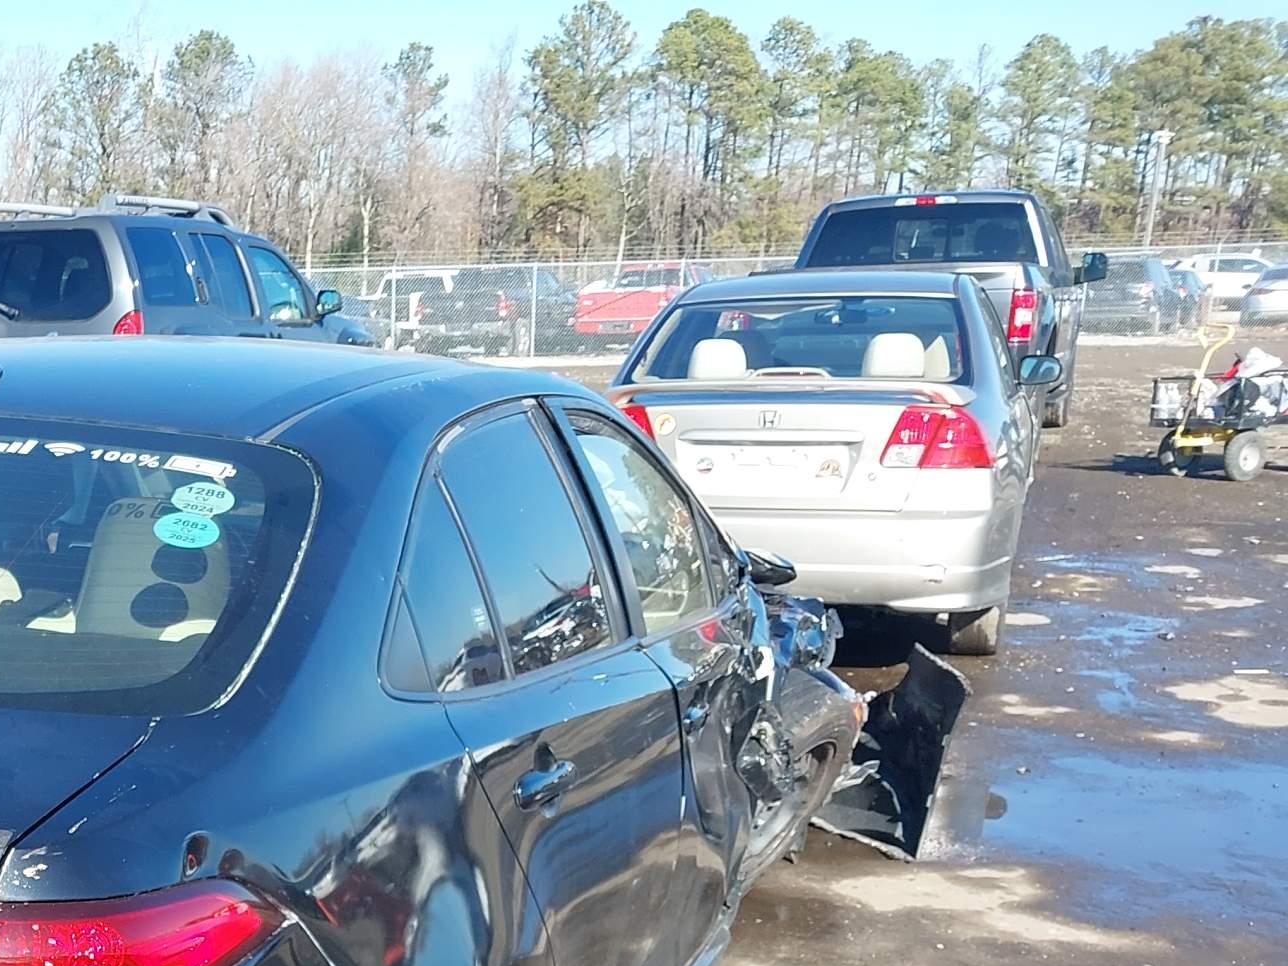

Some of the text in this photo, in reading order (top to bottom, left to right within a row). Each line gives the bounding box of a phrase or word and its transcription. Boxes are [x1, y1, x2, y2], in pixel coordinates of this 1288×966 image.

[89, 448, 160, 469] 100%
[186, 486, 226, 500] 1288
[182, 502, 215, 514] 2024
[173, 517, 209, 531] 2682
[167, 532, 197, 544] 2025
